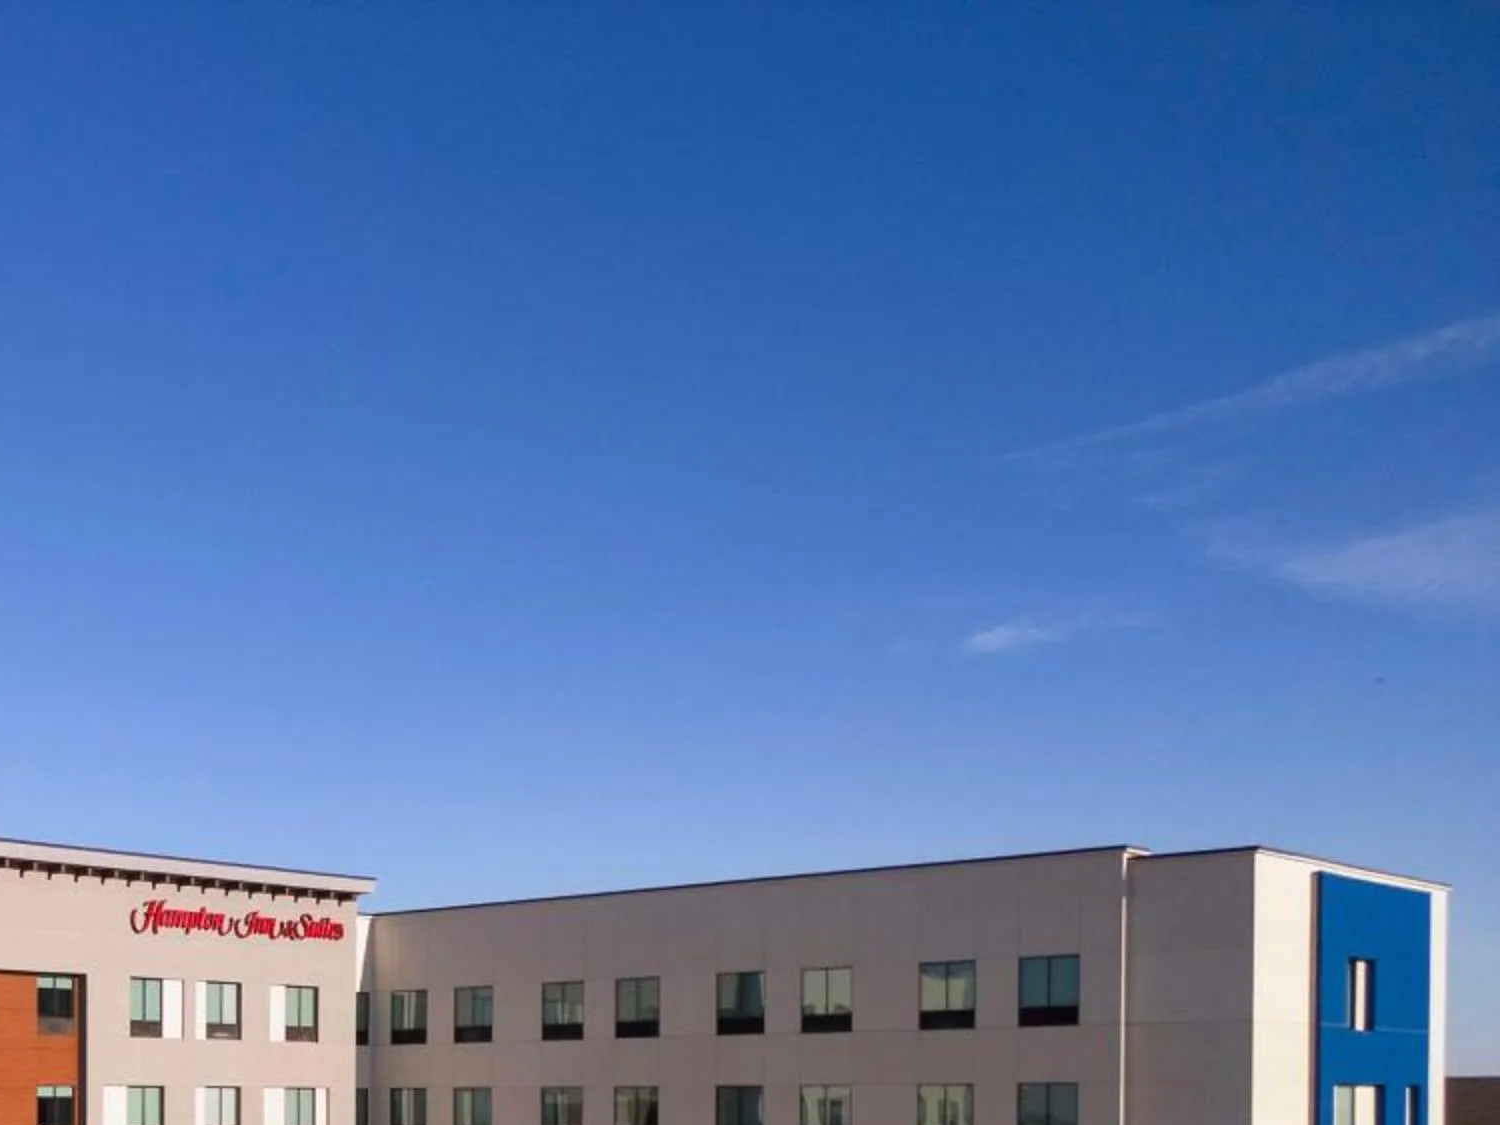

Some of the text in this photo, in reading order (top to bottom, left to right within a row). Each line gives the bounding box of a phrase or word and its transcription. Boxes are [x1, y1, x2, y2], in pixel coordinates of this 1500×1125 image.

[130, 900, 234, 936] Hampton
[234, 910, 283, 939] Inn
[294, 913, 344, 940] Suites
